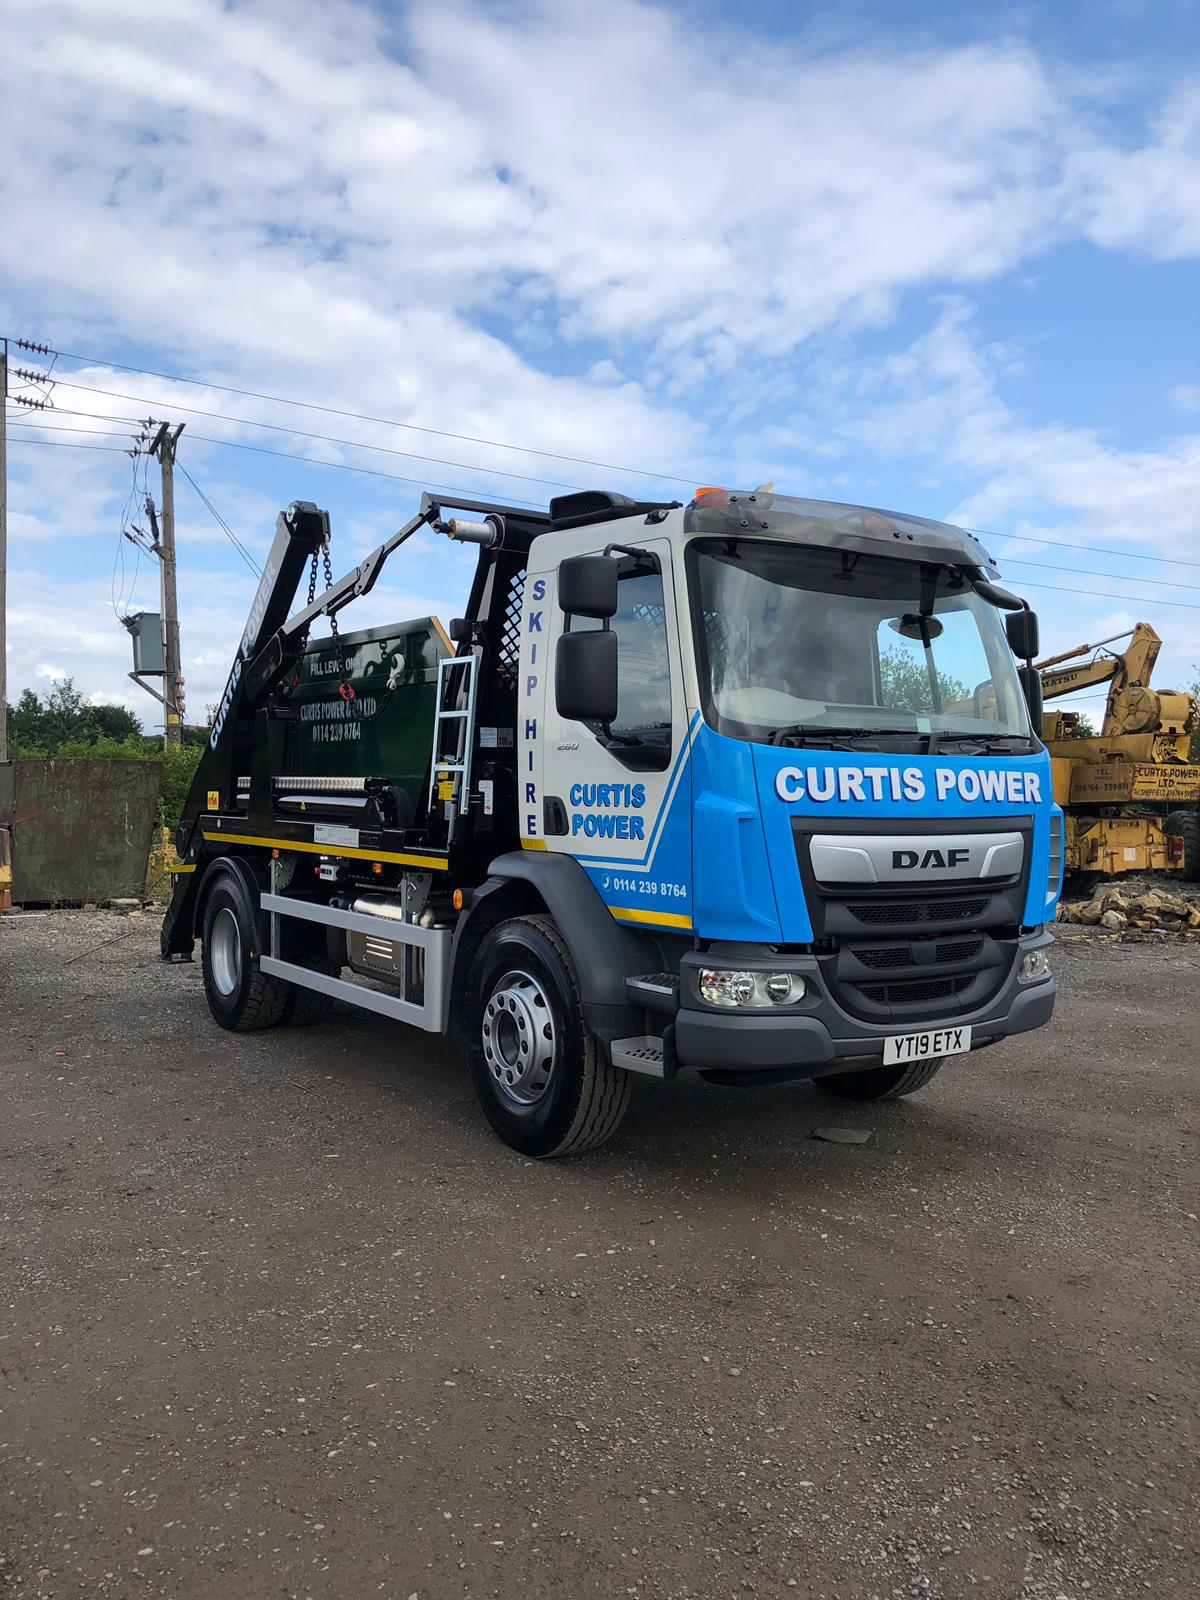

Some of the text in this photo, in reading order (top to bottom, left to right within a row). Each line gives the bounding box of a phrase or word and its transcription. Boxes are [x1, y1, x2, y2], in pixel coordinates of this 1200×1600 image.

[209, 561, 277, 751] CURTIS POWER
[300, 702, 321, 721] CURTIS
[321, 700, 345, 719] POWER
[525, 579, 546, 836] SKIP HIRE
[312, 722, 361, 742] 0114 239 8764
[557, 742, 579, 751] 260
[775, 766, 1042, 803] CURTIS POWER
[1138, 767, 1199, 779] CURTIS POWER
[570, 783, 646, 808] CURTIS
[572, 813, 646, 840] POWER
[892, 848, 969, 869] DAF
[613, 877, 687, 898] 0114 239 8764
[895, 1030, 963, 1058] YT19 ETX
